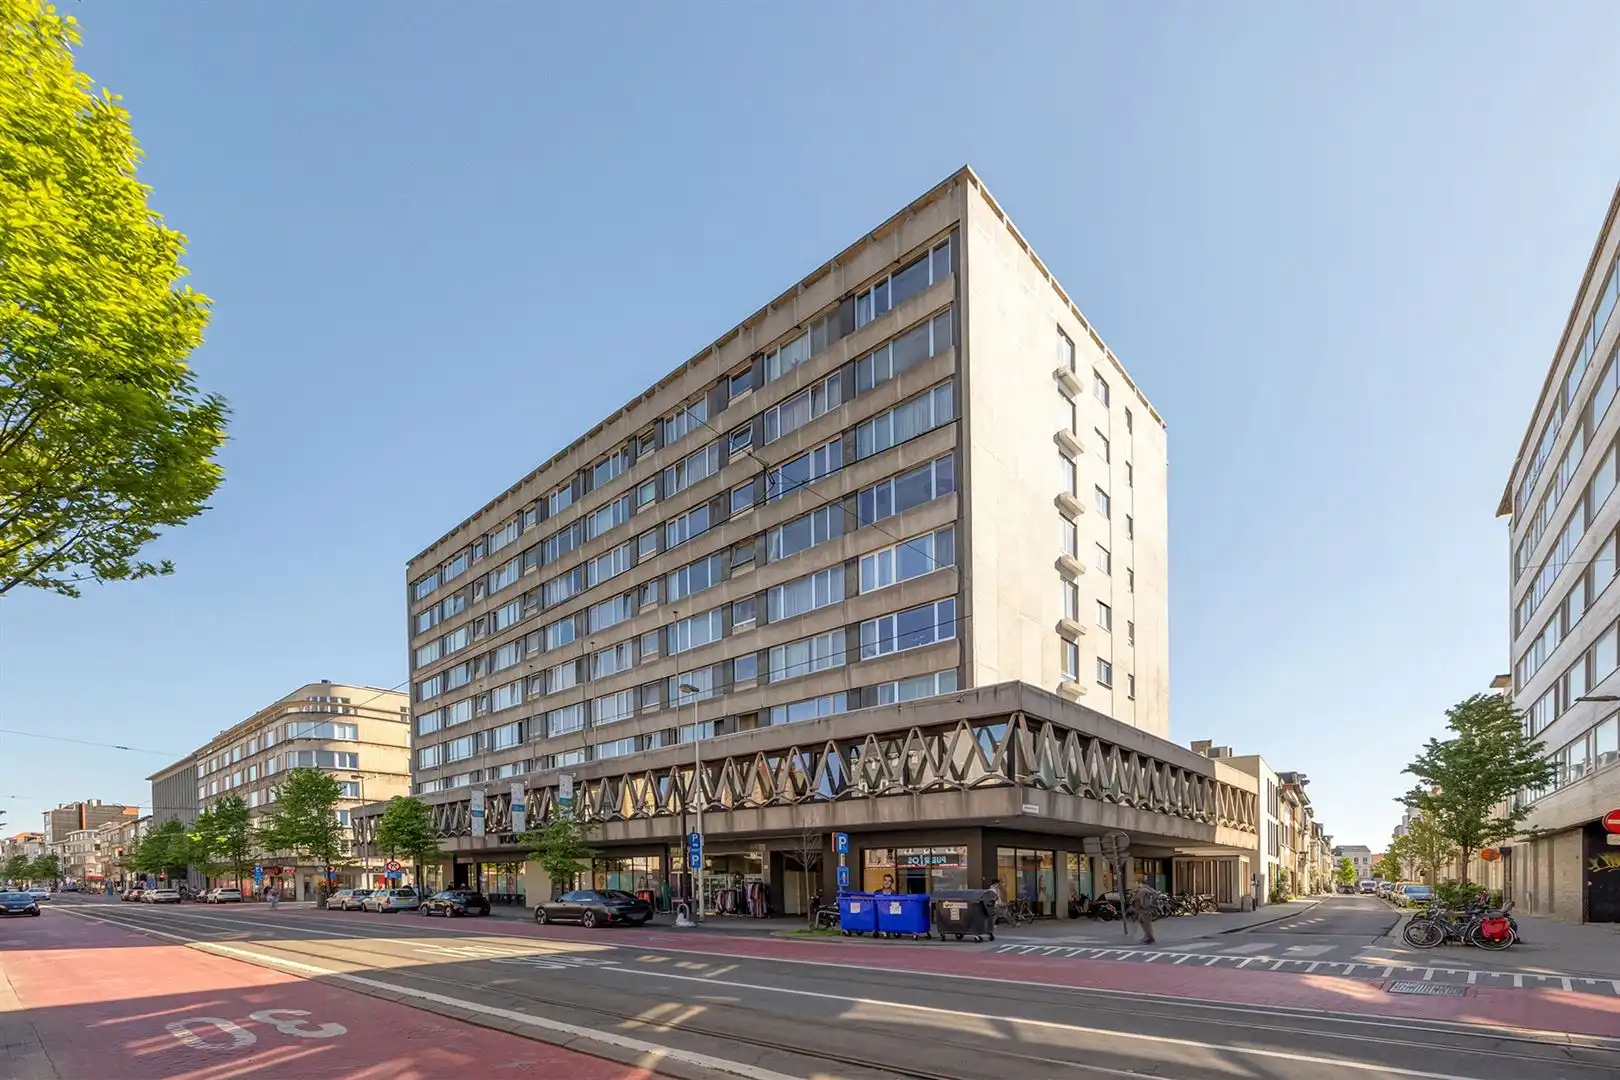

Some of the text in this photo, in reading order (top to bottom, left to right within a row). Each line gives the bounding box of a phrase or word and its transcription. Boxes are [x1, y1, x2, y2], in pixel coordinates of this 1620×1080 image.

[838, 836, 847, 850] P
[691, 855, 699, 866] P
[164, 1008, 348, 1052] 30
